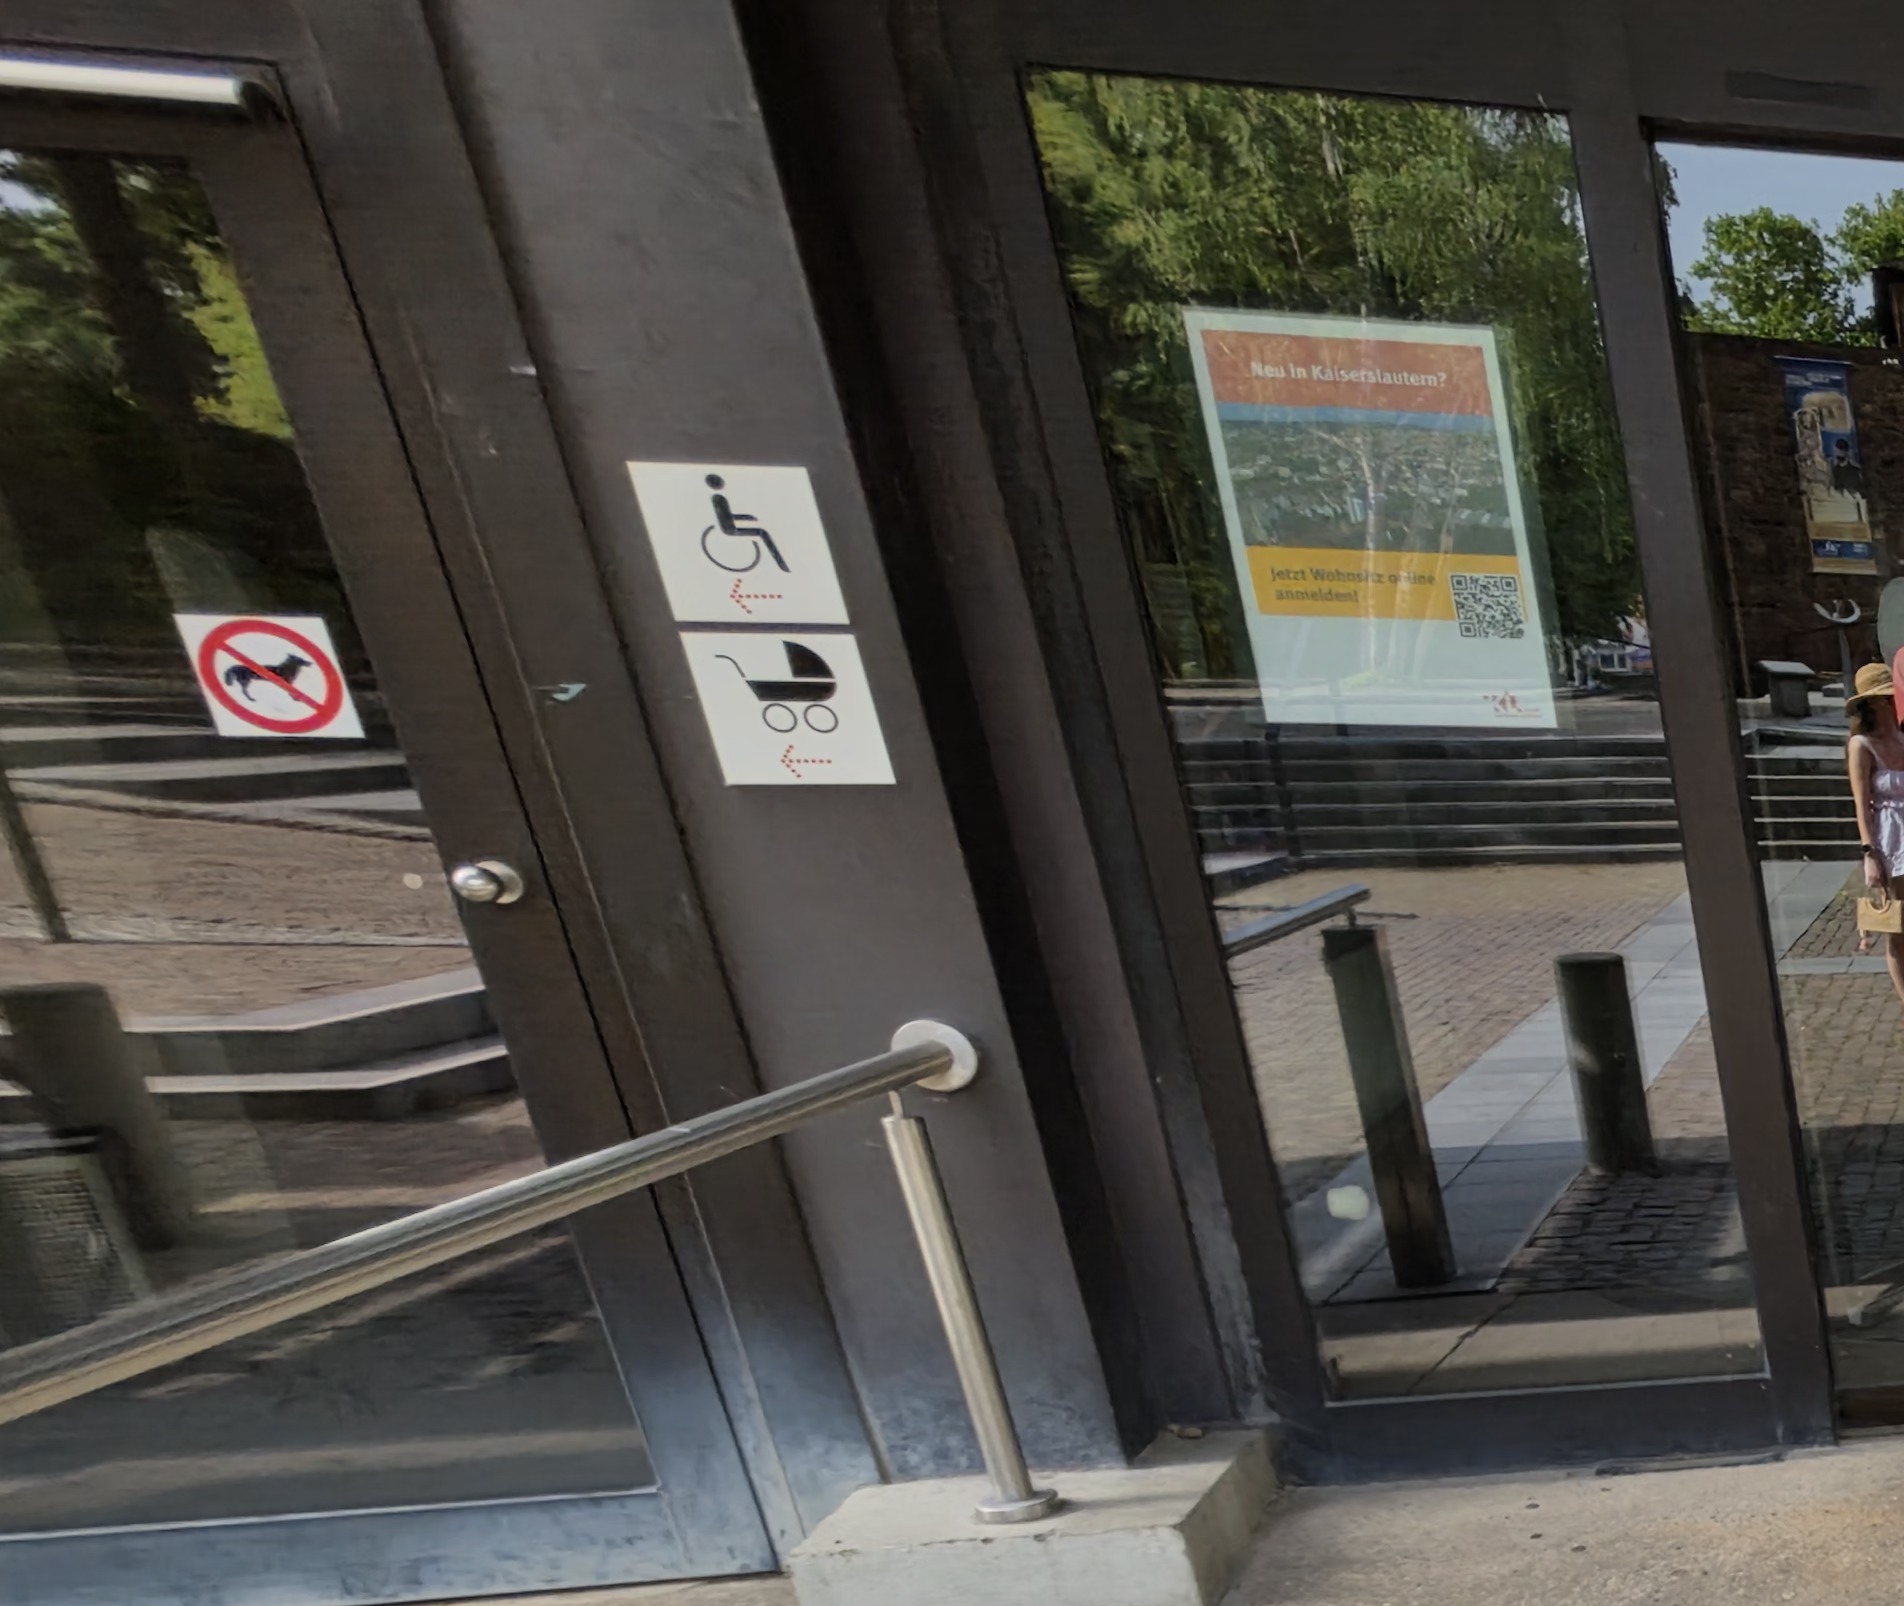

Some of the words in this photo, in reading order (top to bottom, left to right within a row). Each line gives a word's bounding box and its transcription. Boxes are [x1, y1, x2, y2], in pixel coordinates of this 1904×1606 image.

[1251, 361, 1285, 378] Neu
[1291, 363, 1307, 379] in
[1312, 365, 1447, 387] Kaiserslautern?
[1310, 568, 1384, 584] Wohnsitz
[1388, 570, 1436, 585] online
[1275, 589, 1359, 603] anmelden!
